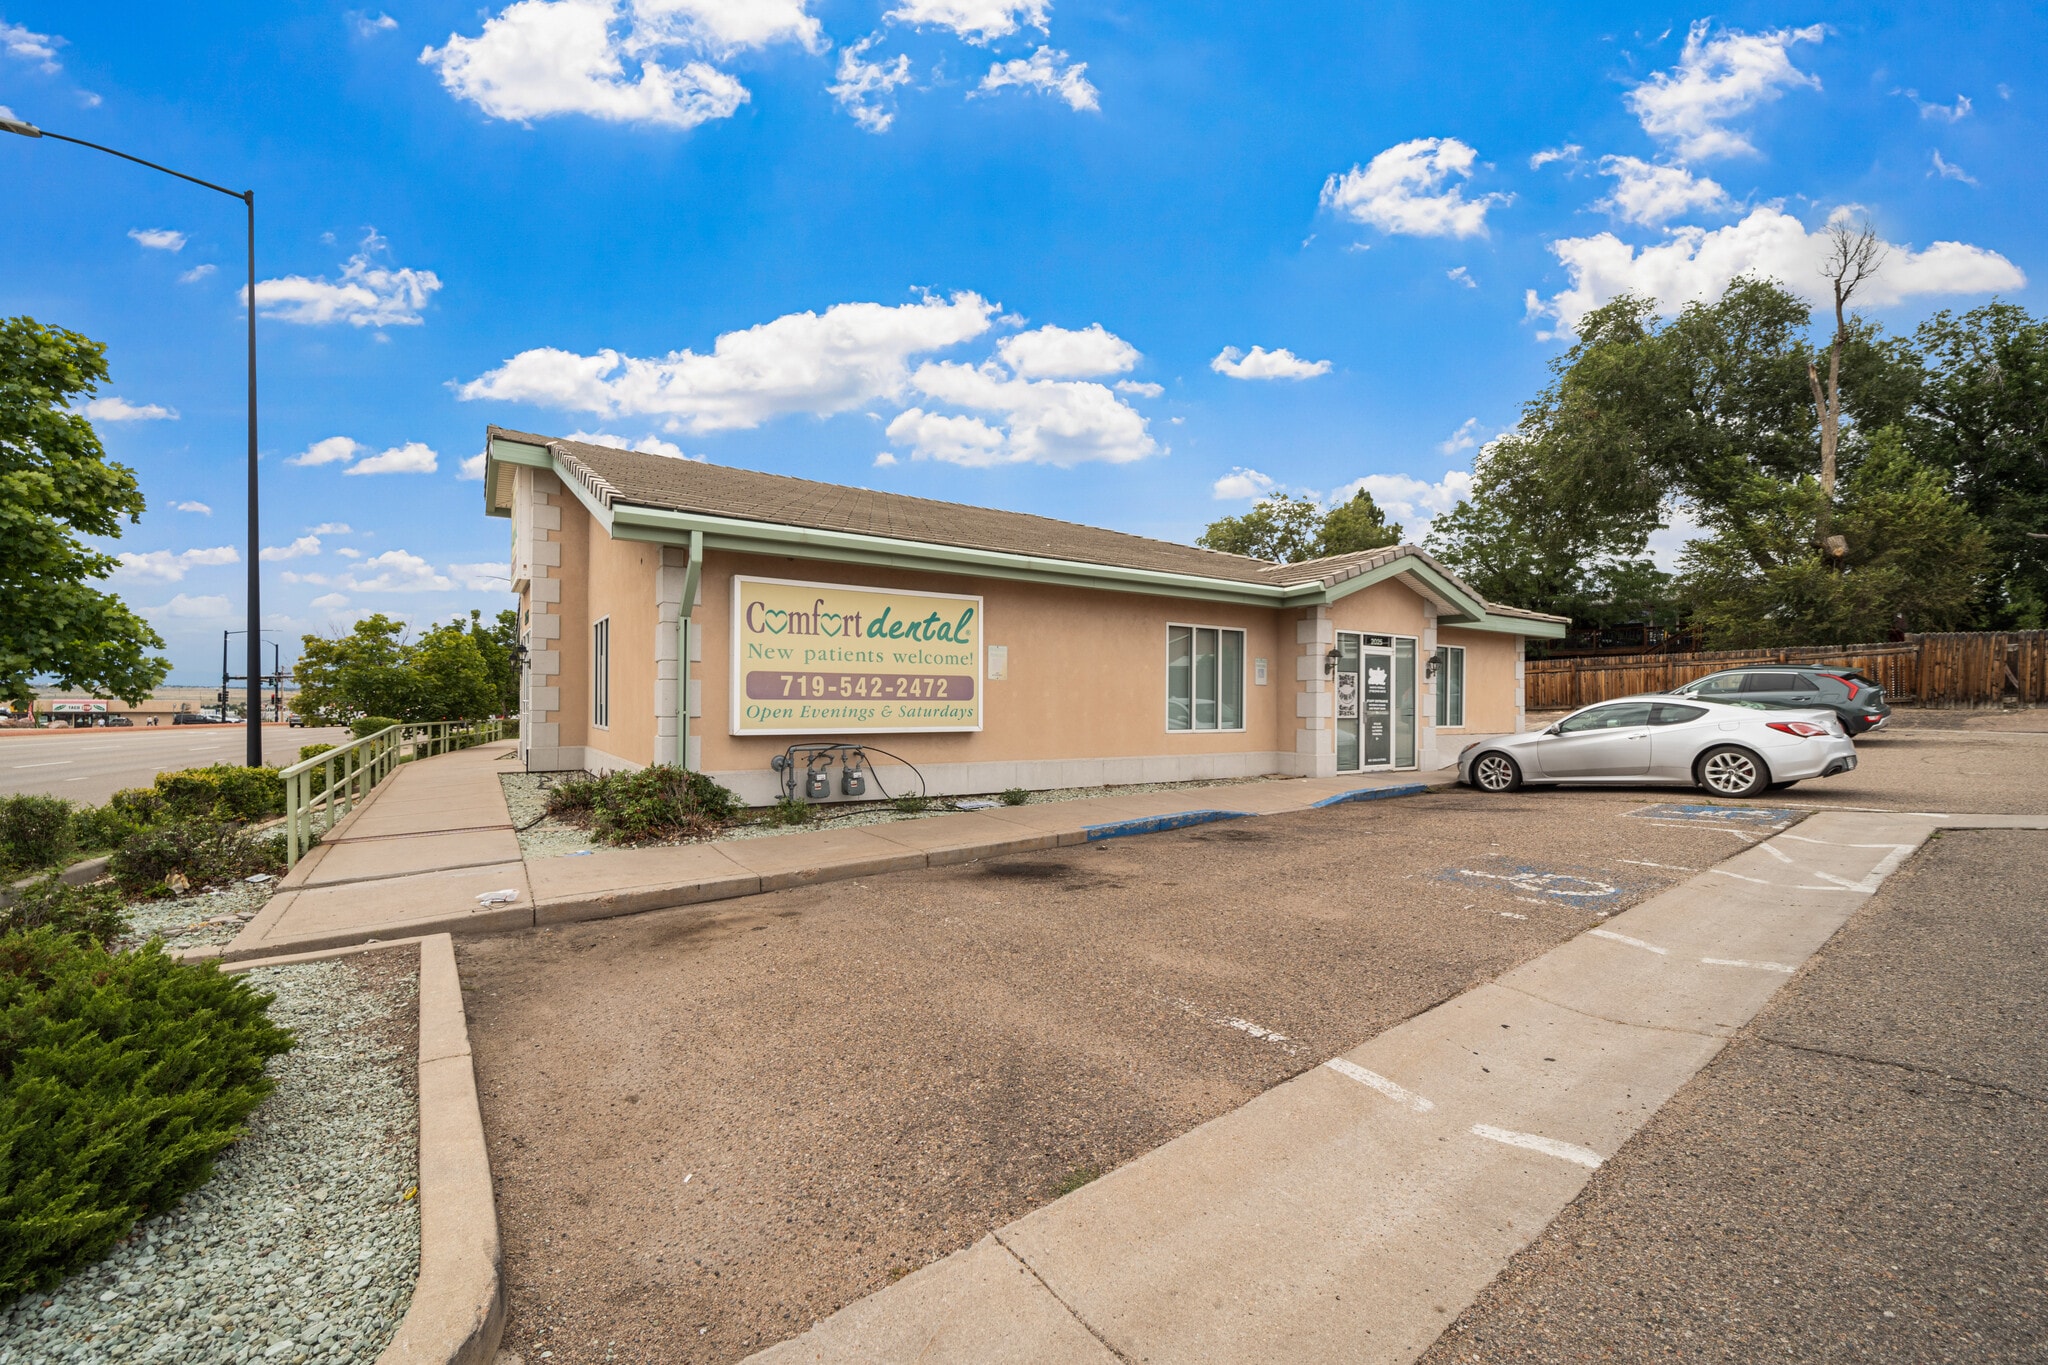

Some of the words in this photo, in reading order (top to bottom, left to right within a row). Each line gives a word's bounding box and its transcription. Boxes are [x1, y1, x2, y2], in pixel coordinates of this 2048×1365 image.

[746, 599, 862, 638] Comfort
[867, 606, 974, 644] dental
[747, 643, 794, 660] New
[804, 647, 884, 664] patients
[893, 649, 974, 666] welcome!
[780, 675, 948, 698] 719-542-2472
[746, 705, 793, 722] Open
[800, 705, 876, 721] Evenings
[881, 705, 893, 718] &
[898, 705, 974, 721] Saturdays
